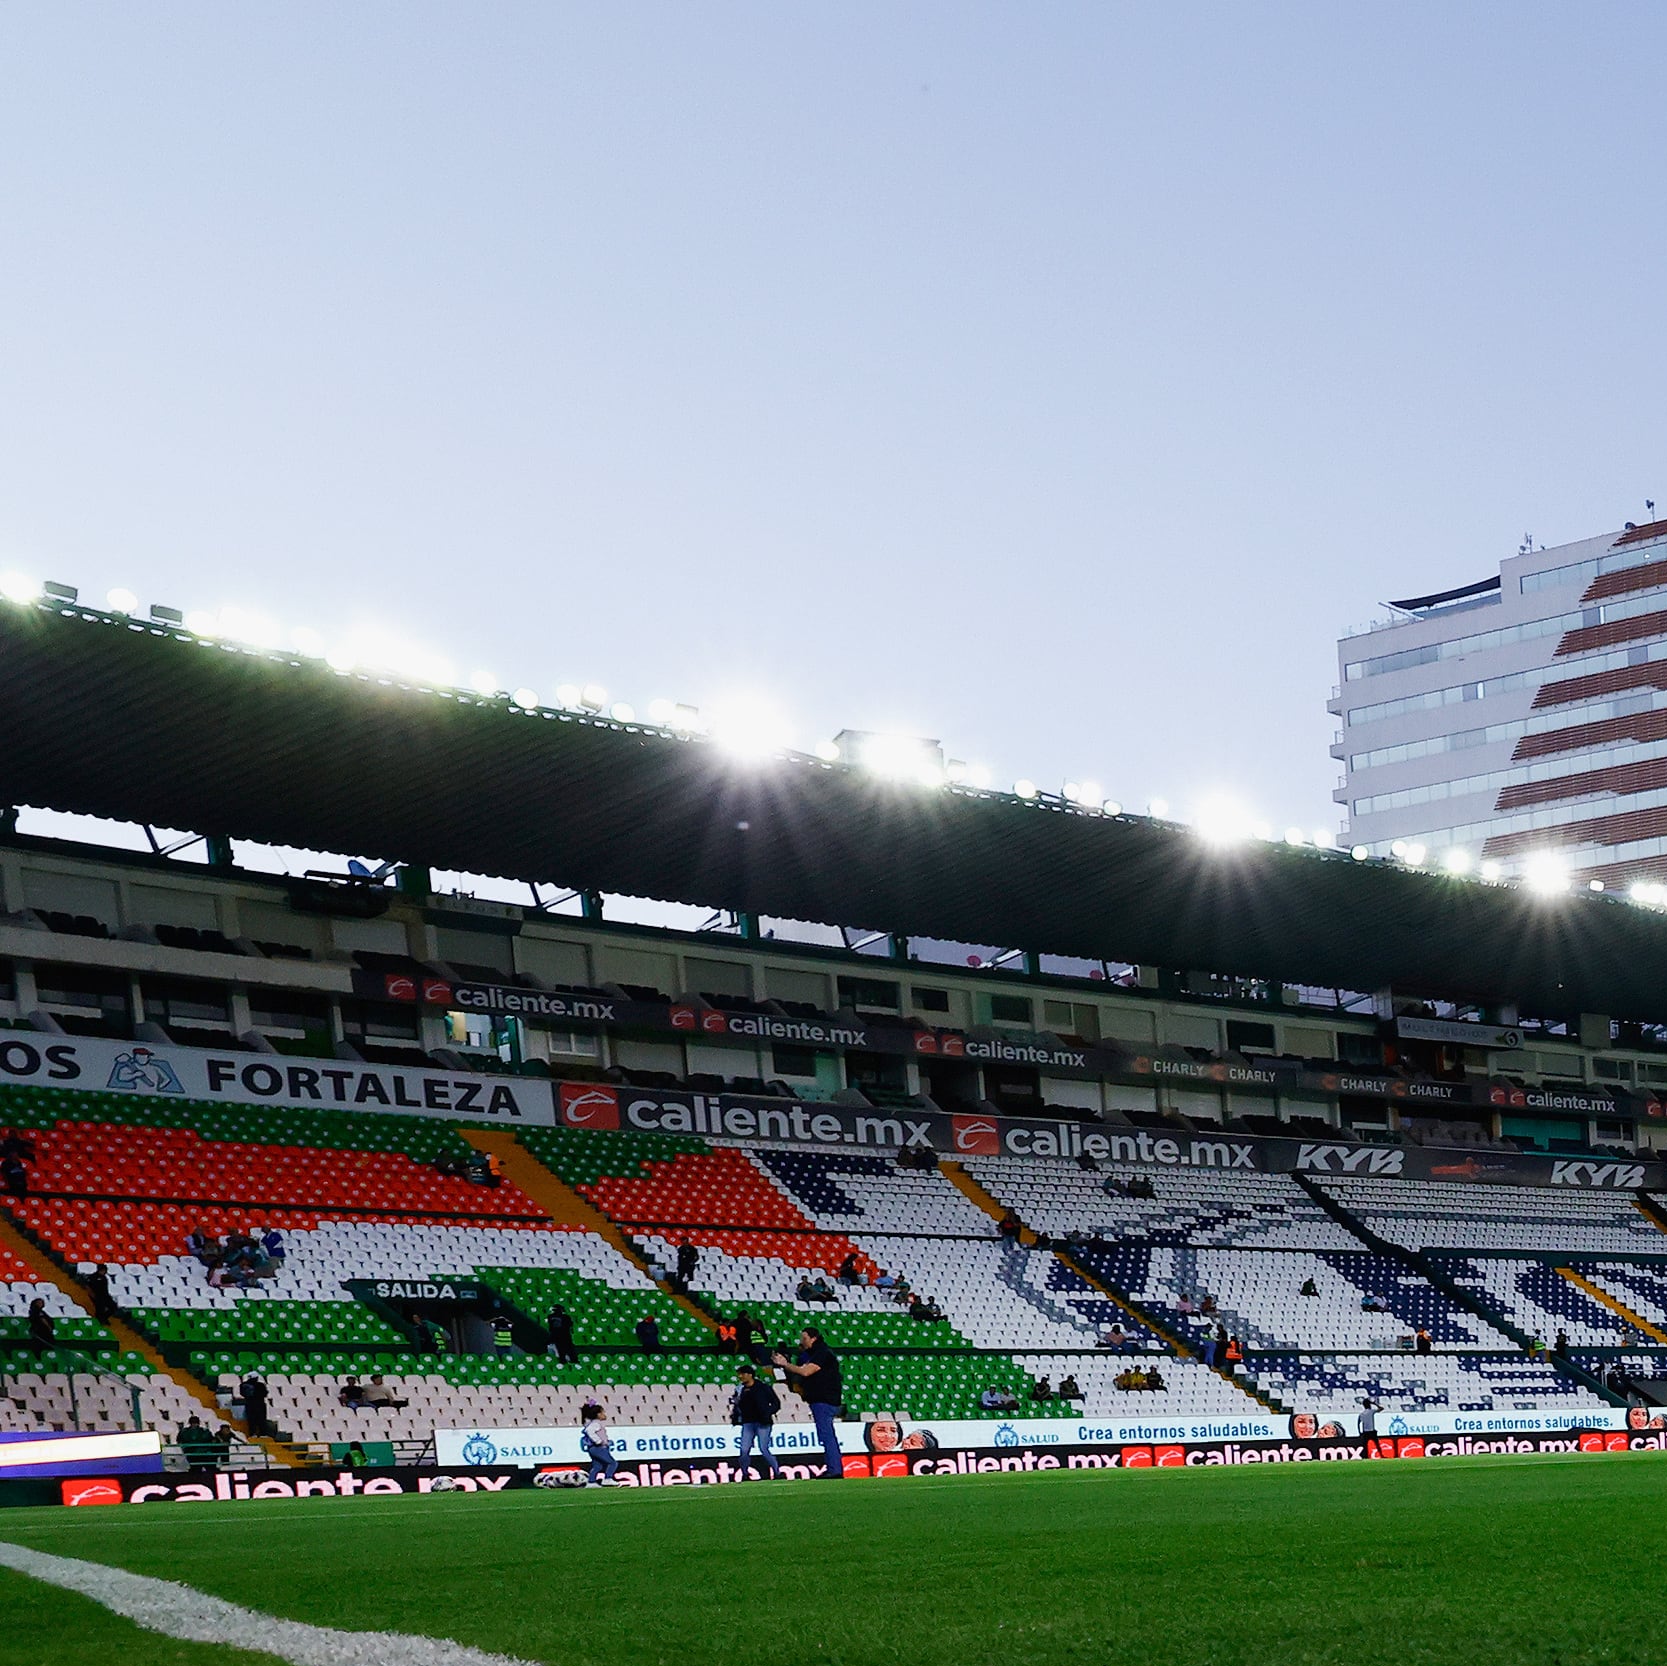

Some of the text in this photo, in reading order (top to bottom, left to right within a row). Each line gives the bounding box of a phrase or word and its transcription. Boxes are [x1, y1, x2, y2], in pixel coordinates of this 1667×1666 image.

[455, 984, 616, 1021] caliente.mx
[728, 1016, 868, 1047] caliente.mx
[964, 1036, 1086, 1068] caliente.mx
[0, 1041, 522, 1117] OS FORTALEZA
[1153, 1060, 1277, 1084] CHARLY CHARLY
[1340, 1076, 1453, 1099] CHARLY CHARLY
[1526, 1091, 1616, 1113] caliente.mx
[627, 1095, 935, 1150] caliente.mx
[1005, 1123, 1256, 1169] caliente.mx
[1297, 1143, 1405, 1175] KYB
[1551, 1160, 1646, 1189] KYB
[375, 1282, 457, 1300] SALIDA
[1021, 1422, 1274, 1444] SALUD Crea entornos saludables.
[1455, 1418, 1483, 1430] Crea
[1487, 1416, 1541, 1429] entornos
[1545, 1414, 1614, 1429] saludables.
[501, 1446, 553, 1457] SALUD
[637, 1434, 726, 1452] entornos
[1186, 1443, 1364, 1466] calientemx
[1425, 1436, 1580, 1456] calientemx
[912, 1450, 1122, 1476] calientemx
[130, 1472, 512, 1503] calientemx
